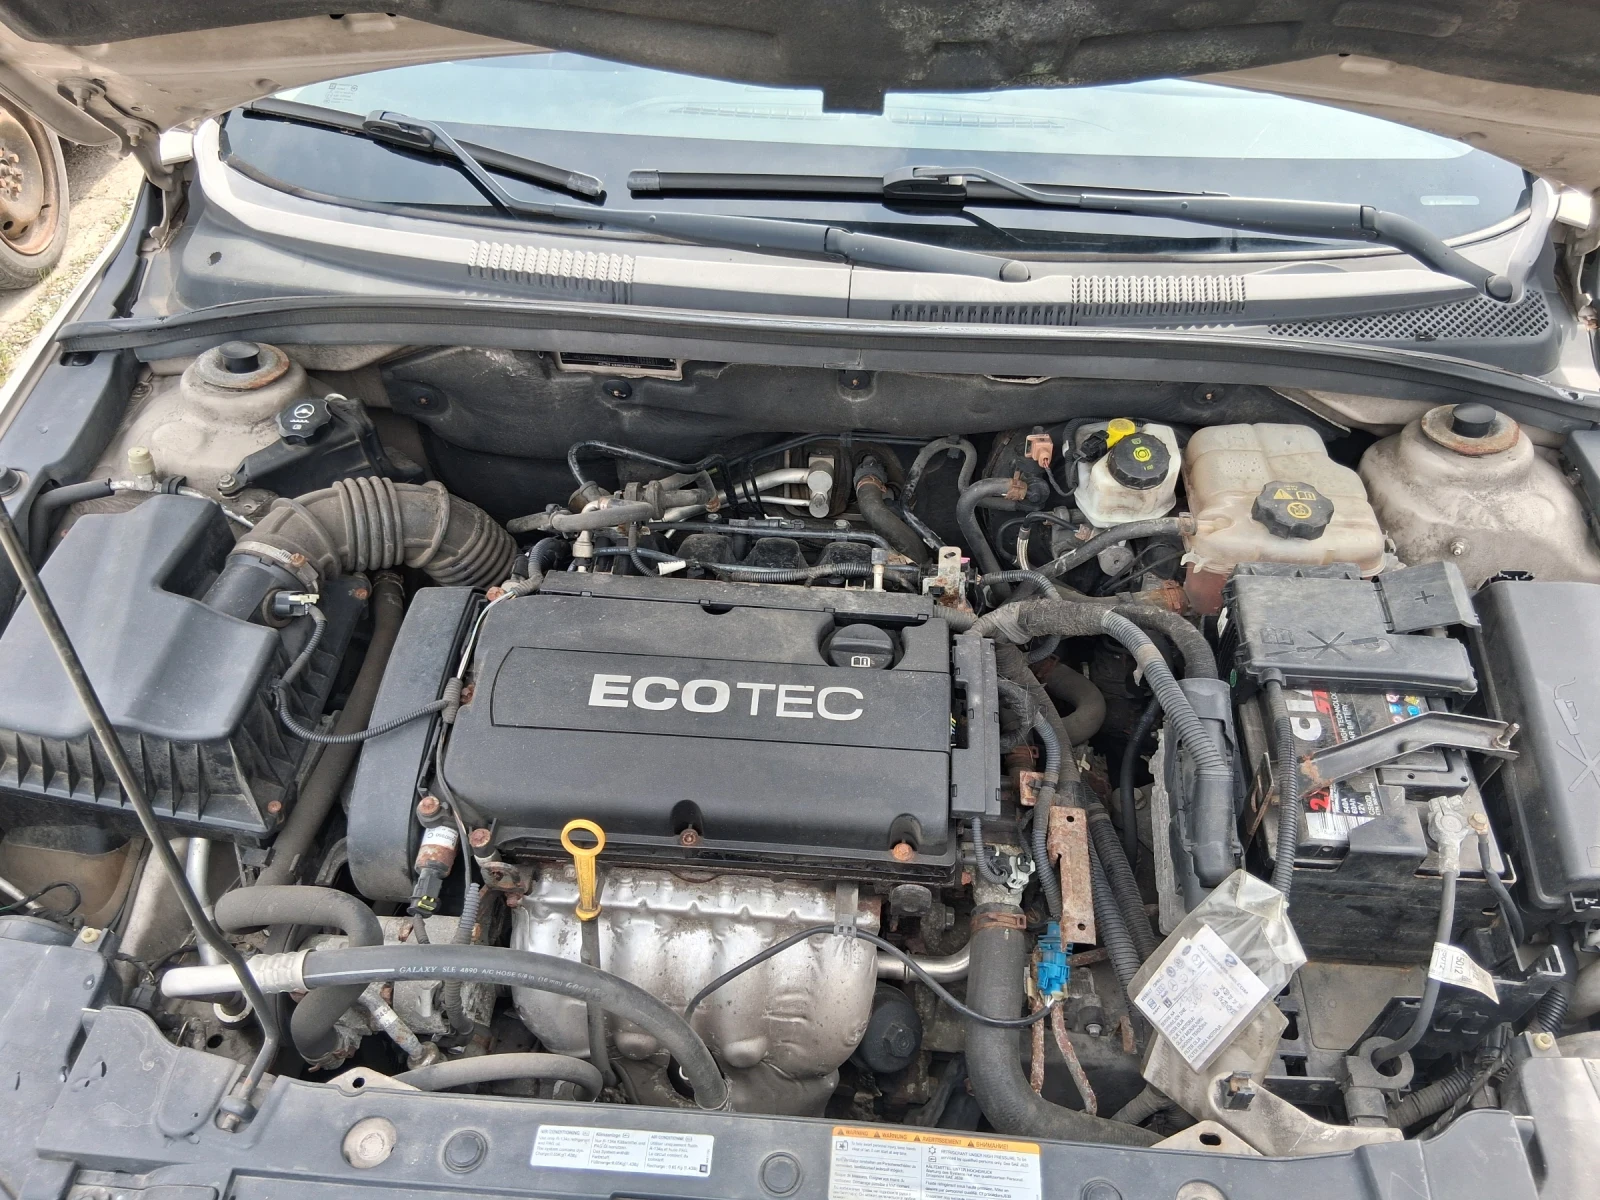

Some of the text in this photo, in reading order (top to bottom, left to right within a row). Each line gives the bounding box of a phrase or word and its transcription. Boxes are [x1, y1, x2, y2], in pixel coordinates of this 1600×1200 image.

[589, 674, 864, 720] ECOTEC
[1357, 802, 1366, 814] 12V
[1454, 956, 1465, 975] 5012
[881, 1132, 908, 1140] WARNUNG
